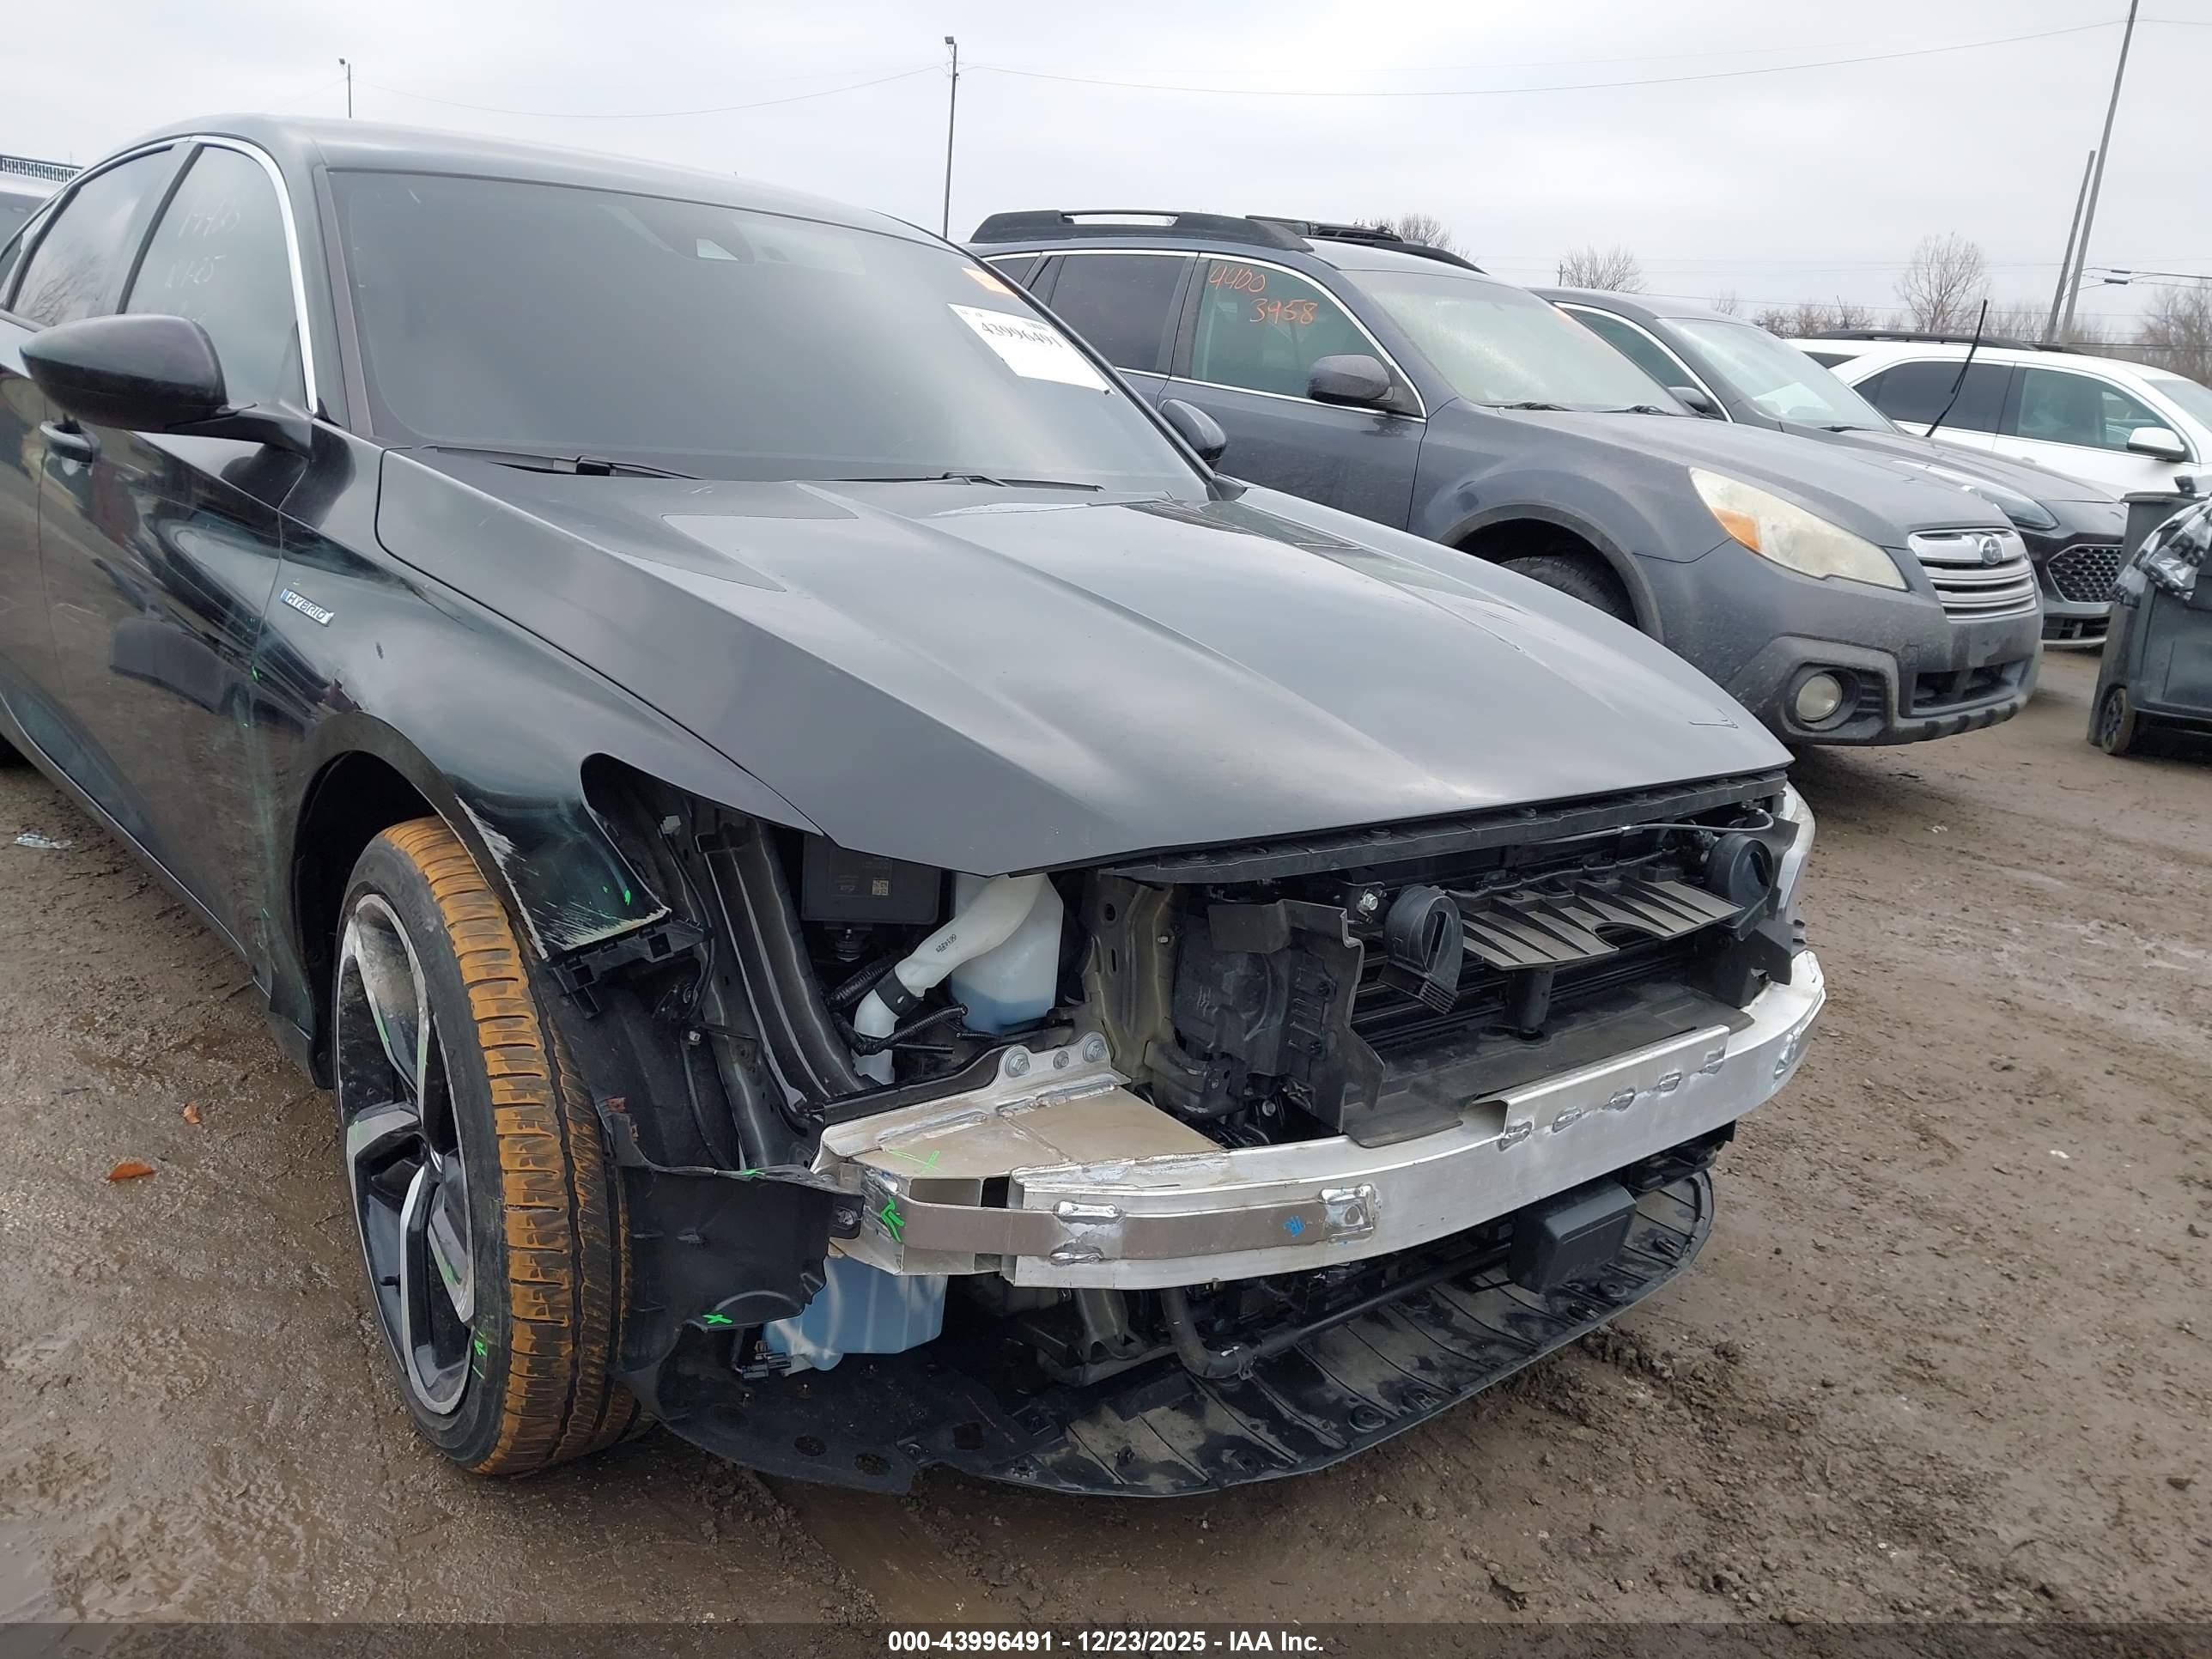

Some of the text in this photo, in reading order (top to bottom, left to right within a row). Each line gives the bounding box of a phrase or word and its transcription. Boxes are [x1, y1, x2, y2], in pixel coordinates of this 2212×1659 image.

[1209, 265, 1267, 293] 4400
[1249, 298, 1319, 325] 3958
[981, 321, 1064, 349] 43996491
[287, 592, 328, 620] HYBRID
